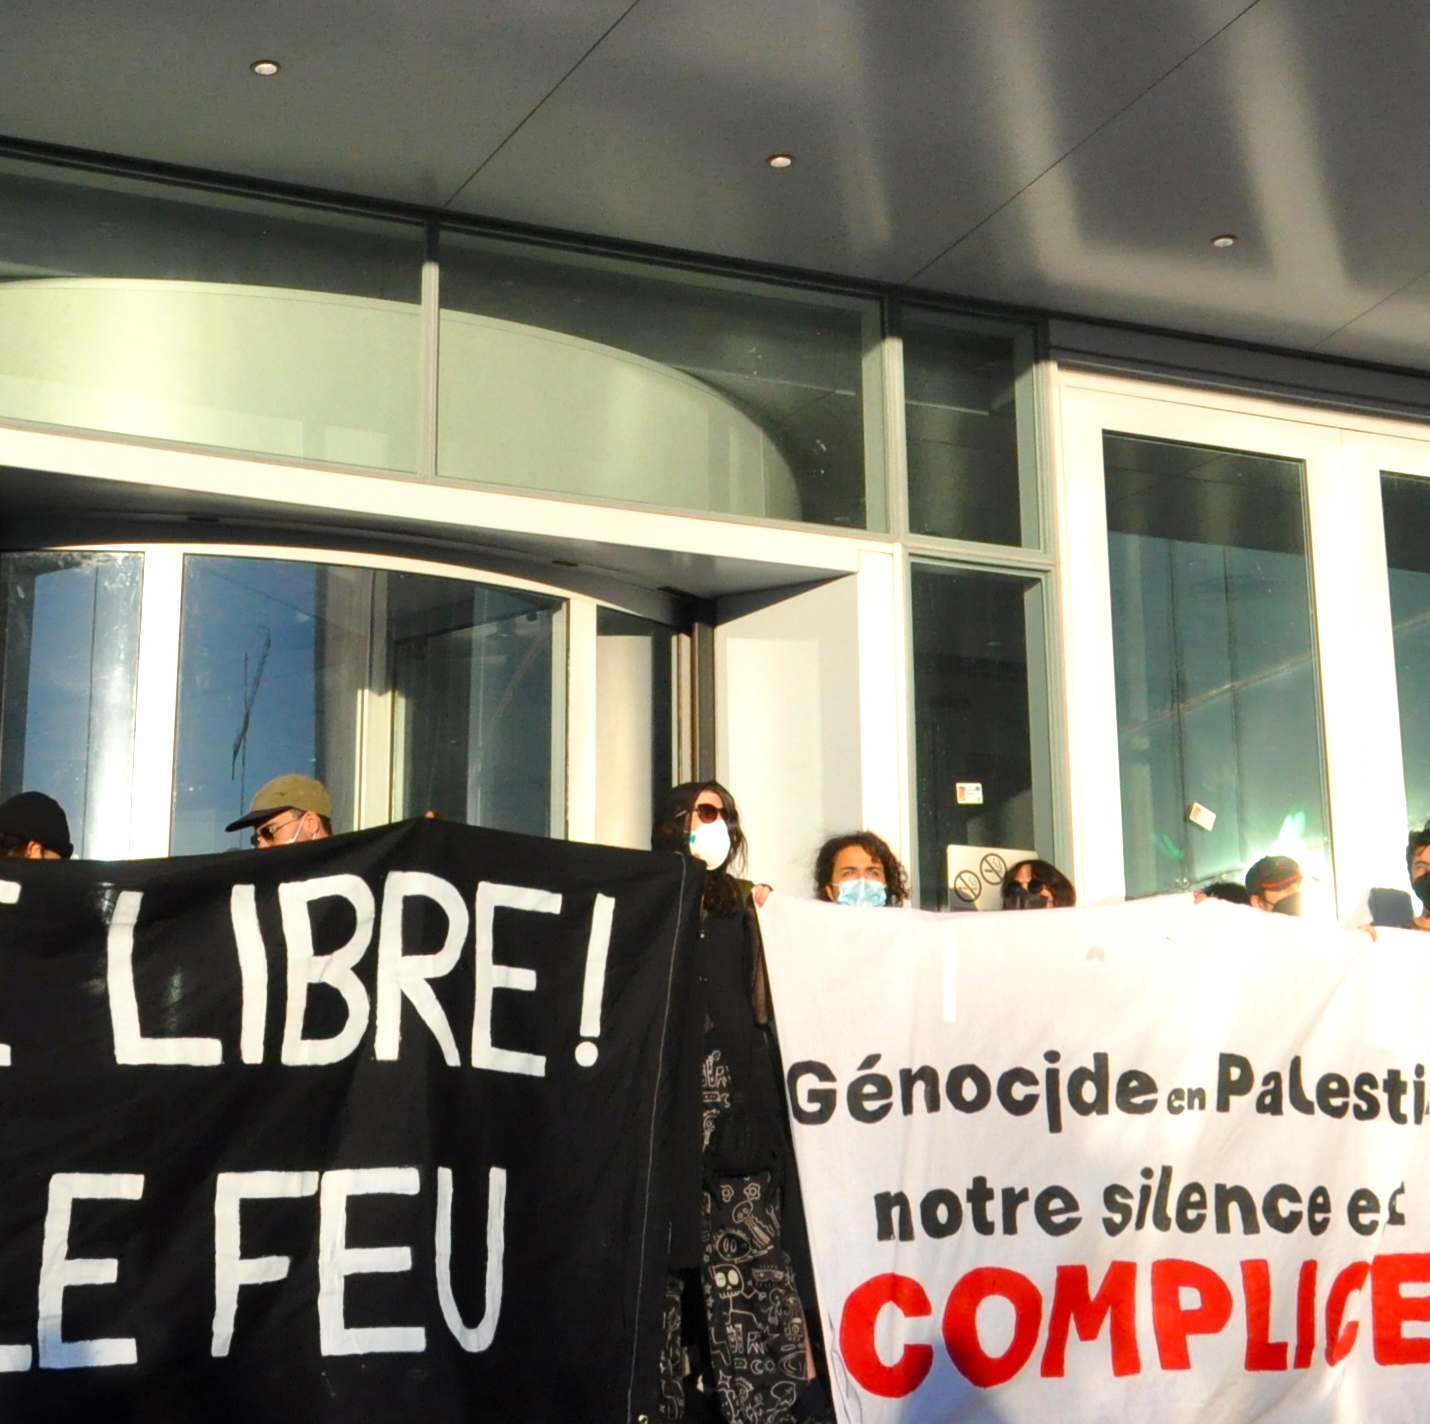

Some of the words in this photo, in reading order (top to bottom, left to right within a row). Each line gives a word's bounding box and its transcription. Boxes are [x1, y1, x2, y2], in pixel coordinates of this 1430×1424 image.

[106, 870, 616, 1078] LIBRE!
[1167, 1088, 1206, 1115] en
[211, 1166, 507, 1358] FEU
[874, 1175, 1082, 1242] notre
[1102, 1165, 1332, 1237] silence
